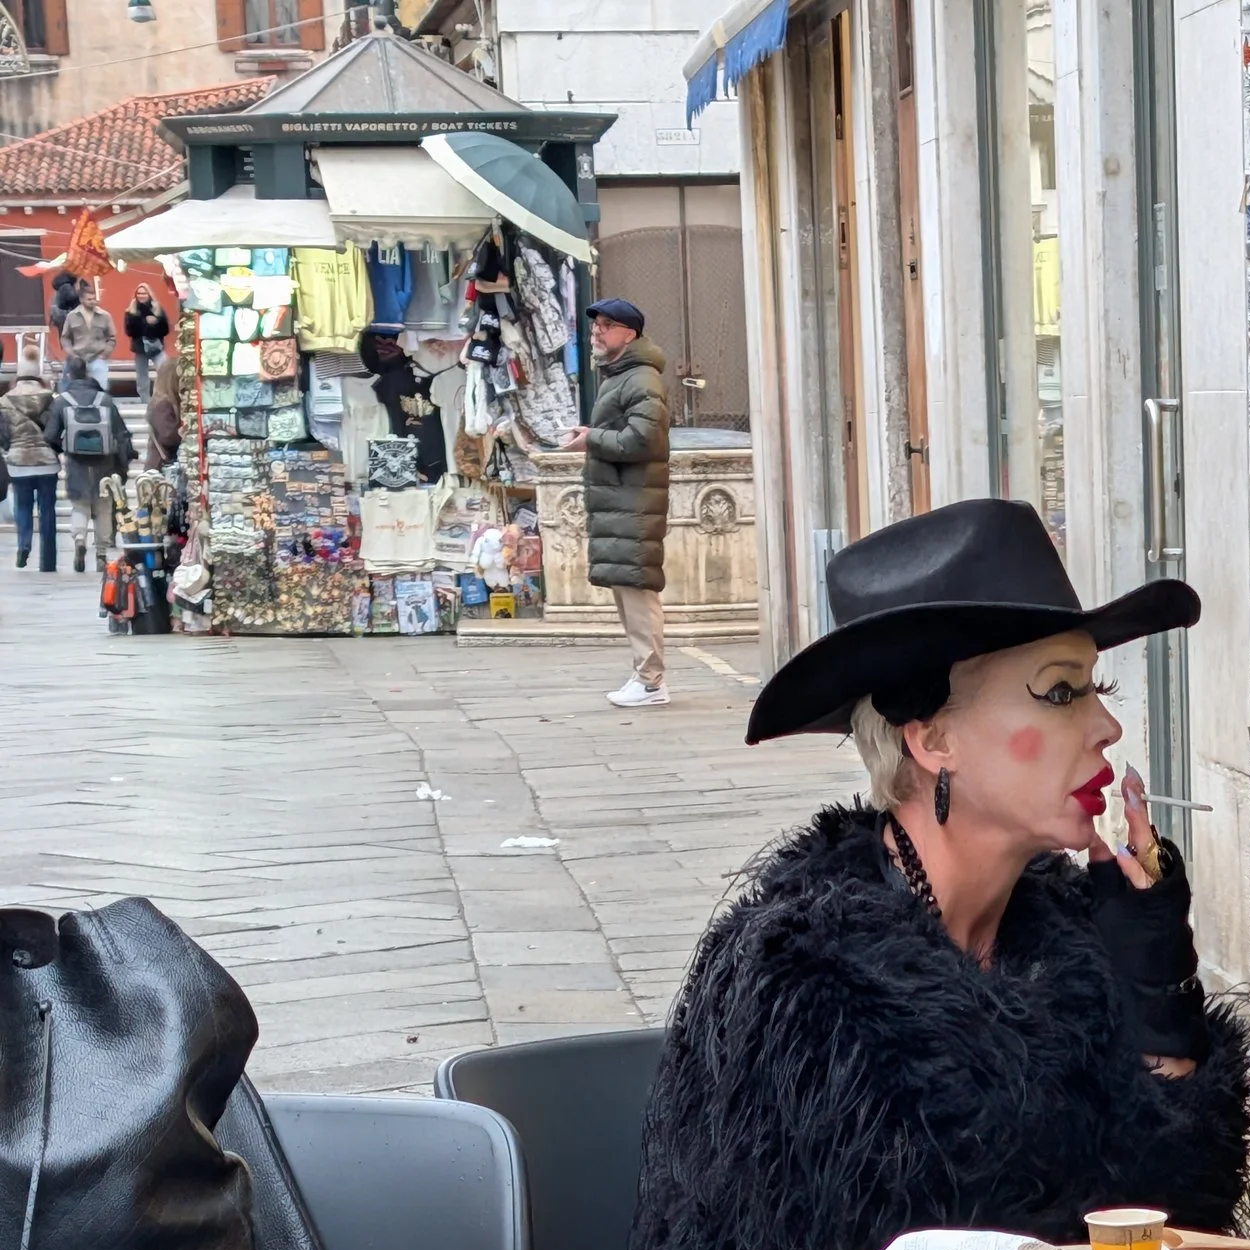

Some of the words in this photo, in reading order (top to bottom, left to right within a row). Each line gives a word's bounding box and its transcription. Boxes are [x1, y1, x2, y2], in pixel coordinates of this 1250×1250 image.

[281, 123, 343, 132] BIGLIETTI
[344, 122, 418, 132] VAPORETTO
[421, 123, 428, 131] /
[431, 122, 463, 131] BOAT
[467, 121, 519, 131] TICKETS
